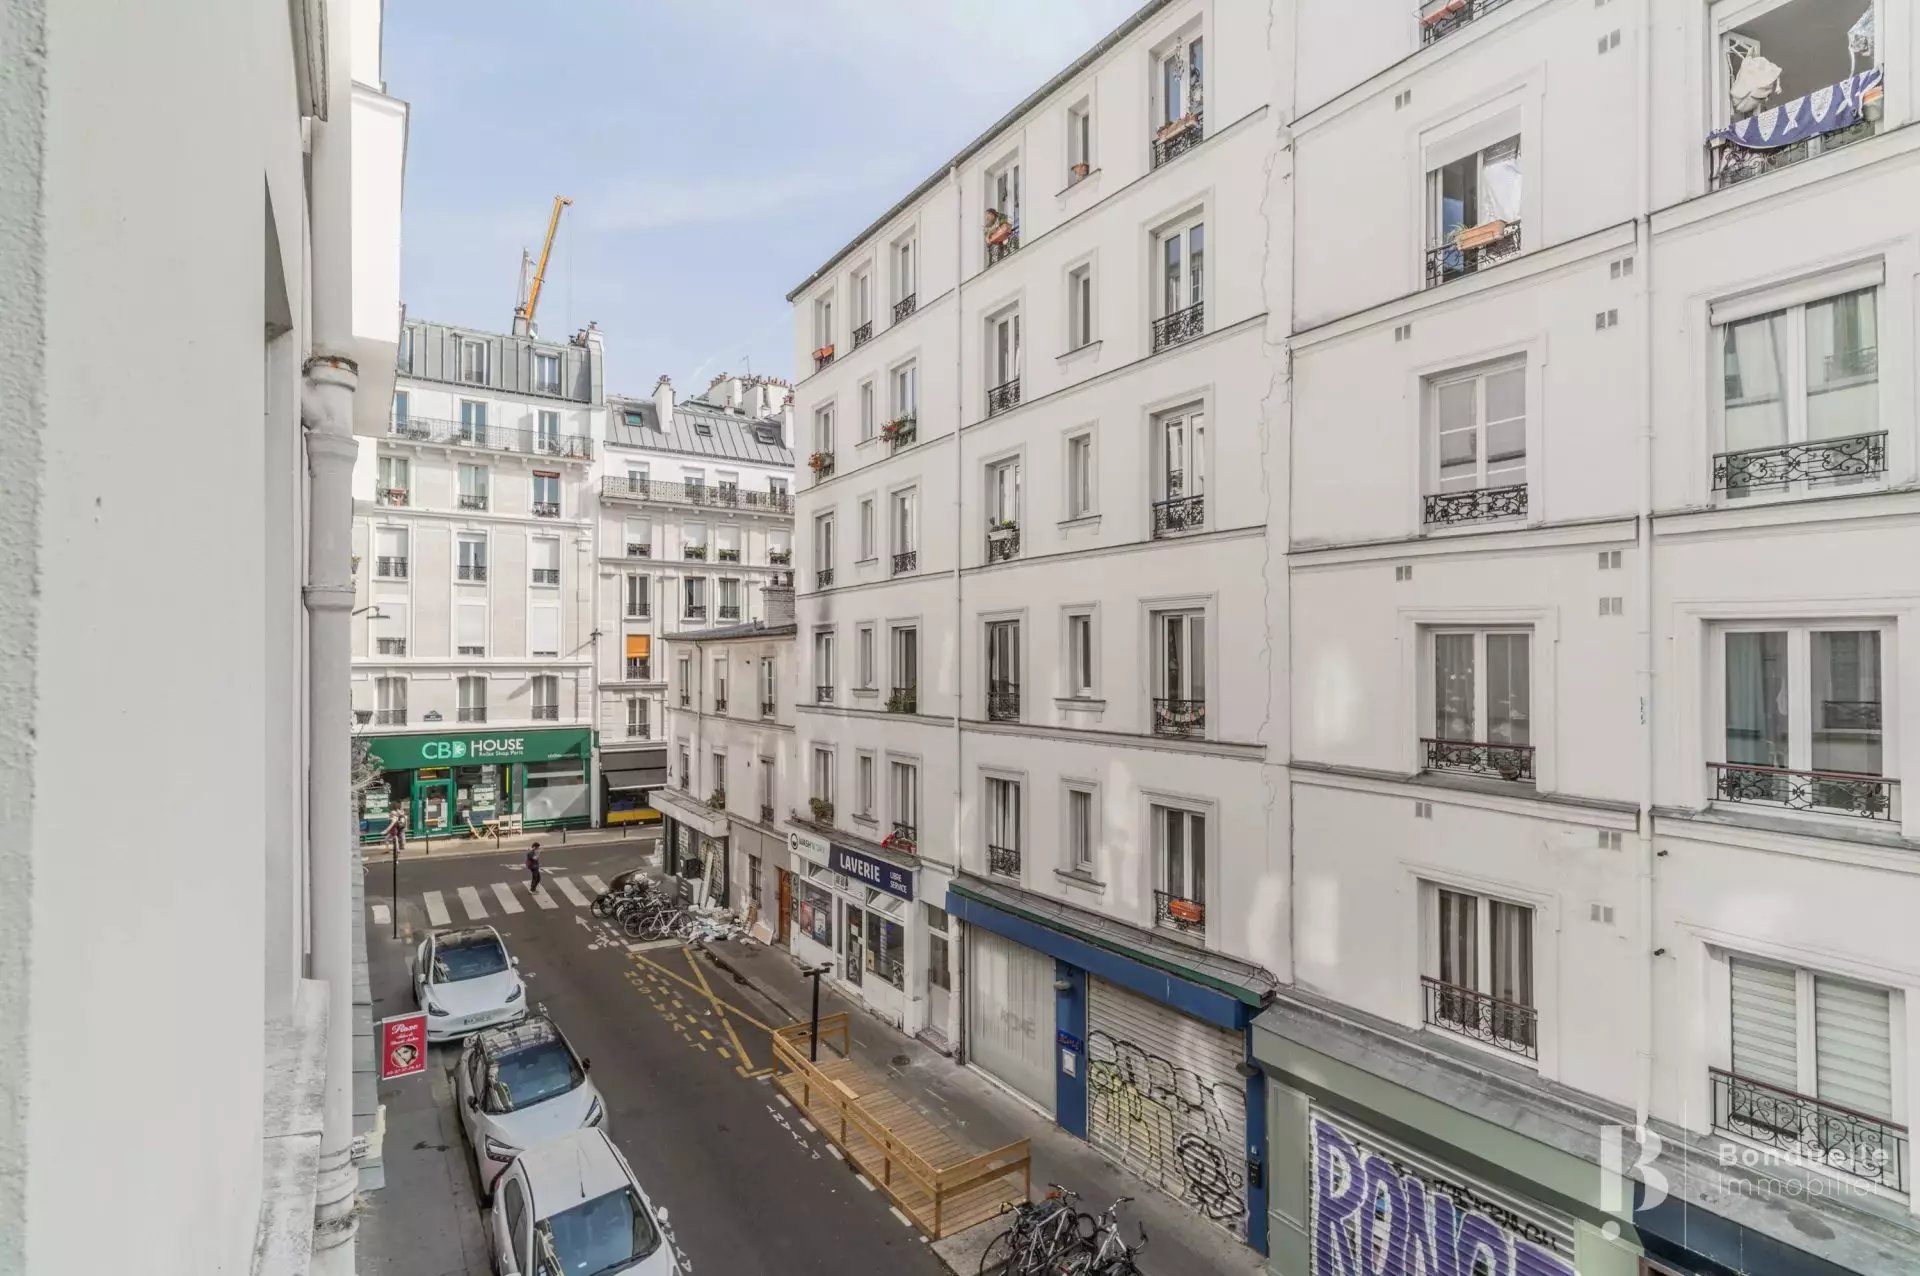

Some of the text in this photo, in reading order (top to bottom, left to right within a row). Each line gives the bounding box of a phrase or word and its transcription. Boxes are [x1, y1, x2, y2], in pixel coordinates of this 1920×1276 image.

[422, 738, 524, 759] CBD HOUSE
[840, 852, 880, 883] LAVERIE
[890, 871, 902, 882] LIBRE
[890, 880, 907, 894] SERVICE
[766, 1104, 821, 1160] PAYANT
